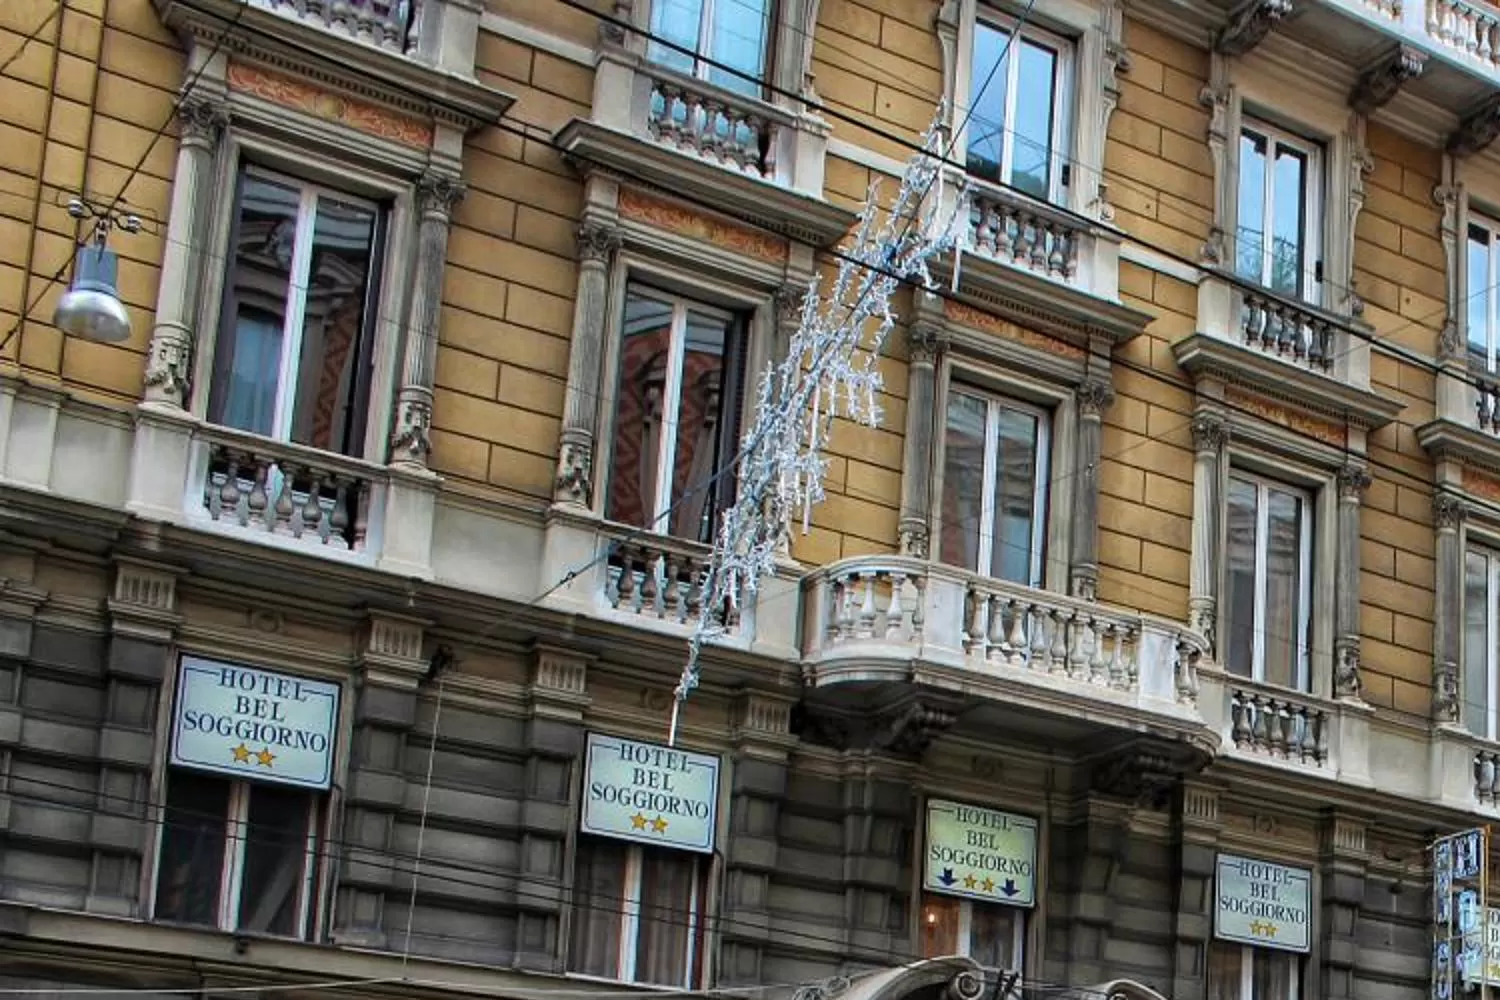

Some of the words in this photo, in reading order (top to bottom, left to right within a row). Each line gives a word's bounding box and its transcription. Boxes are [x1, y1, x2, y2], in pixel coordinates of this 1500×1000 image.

[218, 667, 307, 702] HOTEL
[235, 695, 286, 723] BEL
[183, 709, 327, 753] SOGGIORNO
[620, 743, 692, 774] HOTEL
[633, 767, 674, 793] BEL
[591, 781, 709, 820] SOGGIORNO
[956, 806, 1012, 833] HOTEL
[966, 829, 1000, 851] BEL
[930, 844, 1032, 877] SOGGIORNO
[1239, 861, 1293, 886] HOTEL
[1250, 881, 1281, 902] BEL
[1220, 895, 1305, 925] SOGGIORNO
